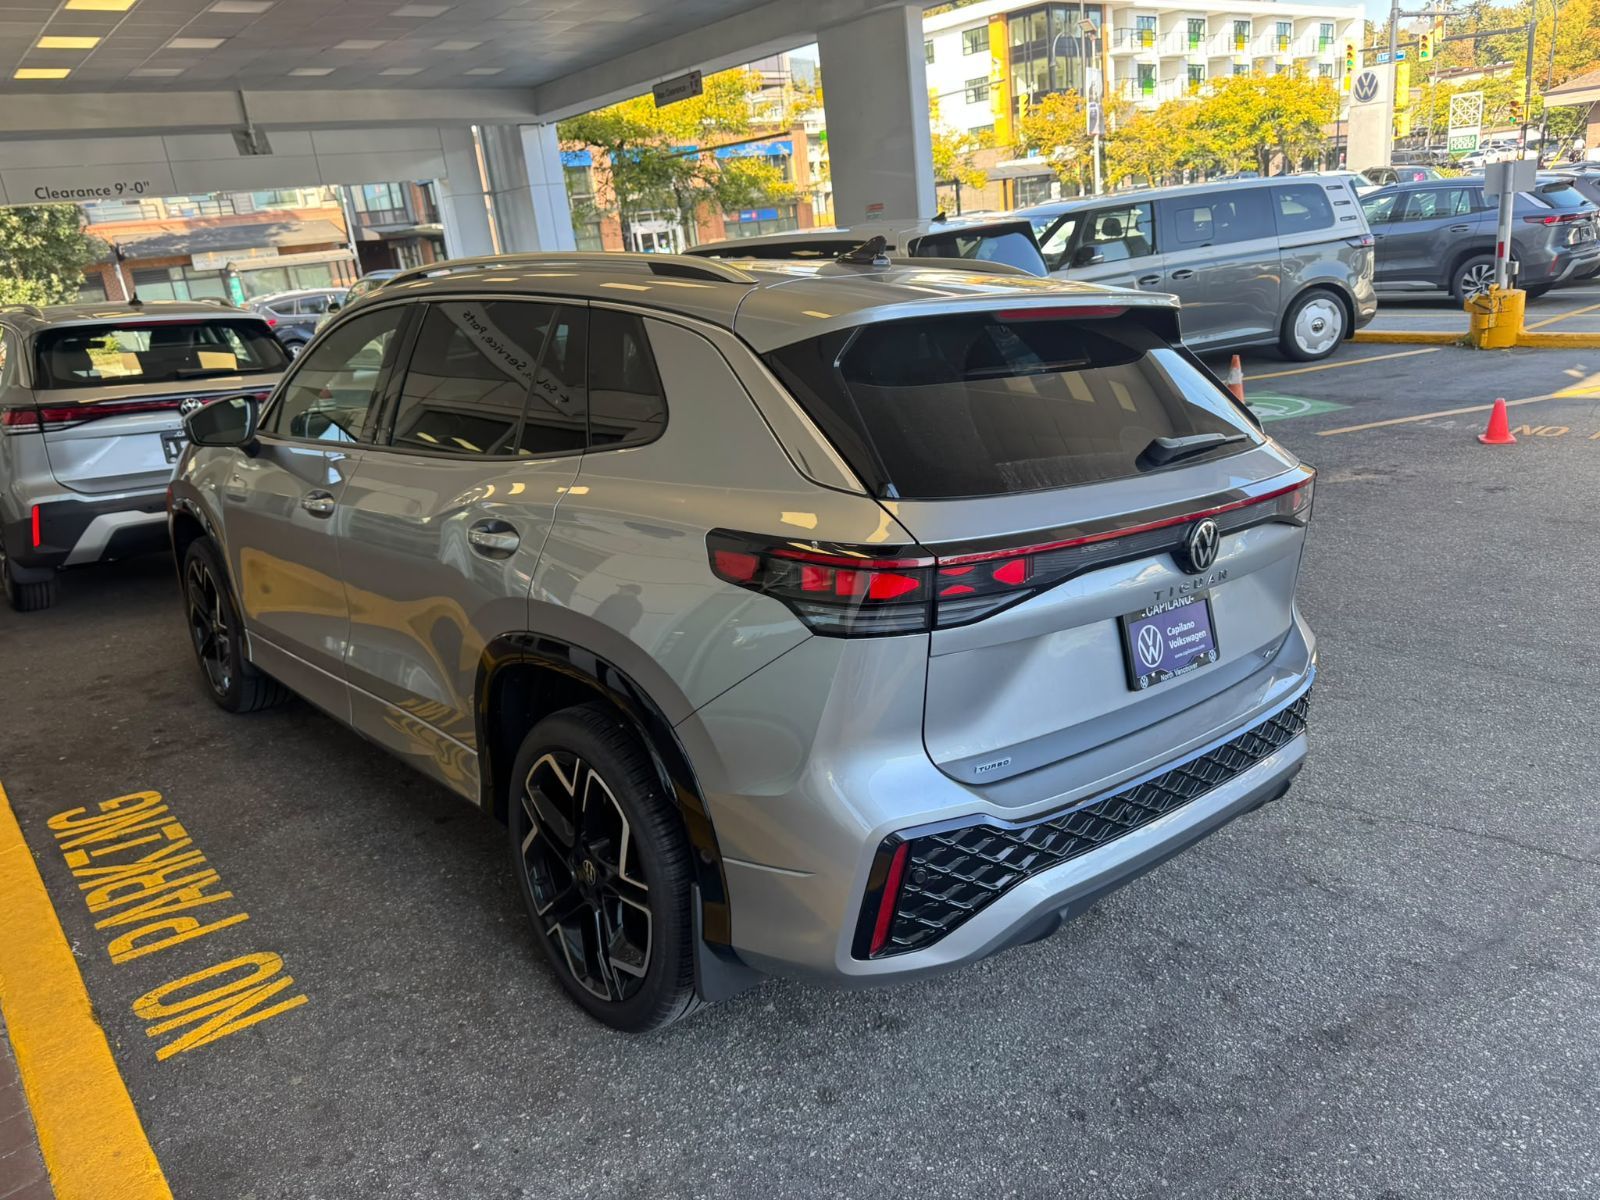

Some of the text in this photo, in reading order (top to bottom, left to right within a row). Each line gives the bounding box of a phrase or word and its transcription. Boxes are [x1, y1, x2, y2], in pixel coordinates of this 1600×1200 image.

[34, 181, 150, 200] Clearance 9'-0"
[1191, 518, 1220, 571] VW
[1153, 568, 1228, 601] TIGUAN
[1166, 620, 1196, 637] Capilano
[1168, 630, 1207, 650] Volkswagen
[47, 790, 310, 1063] NO PARKING
